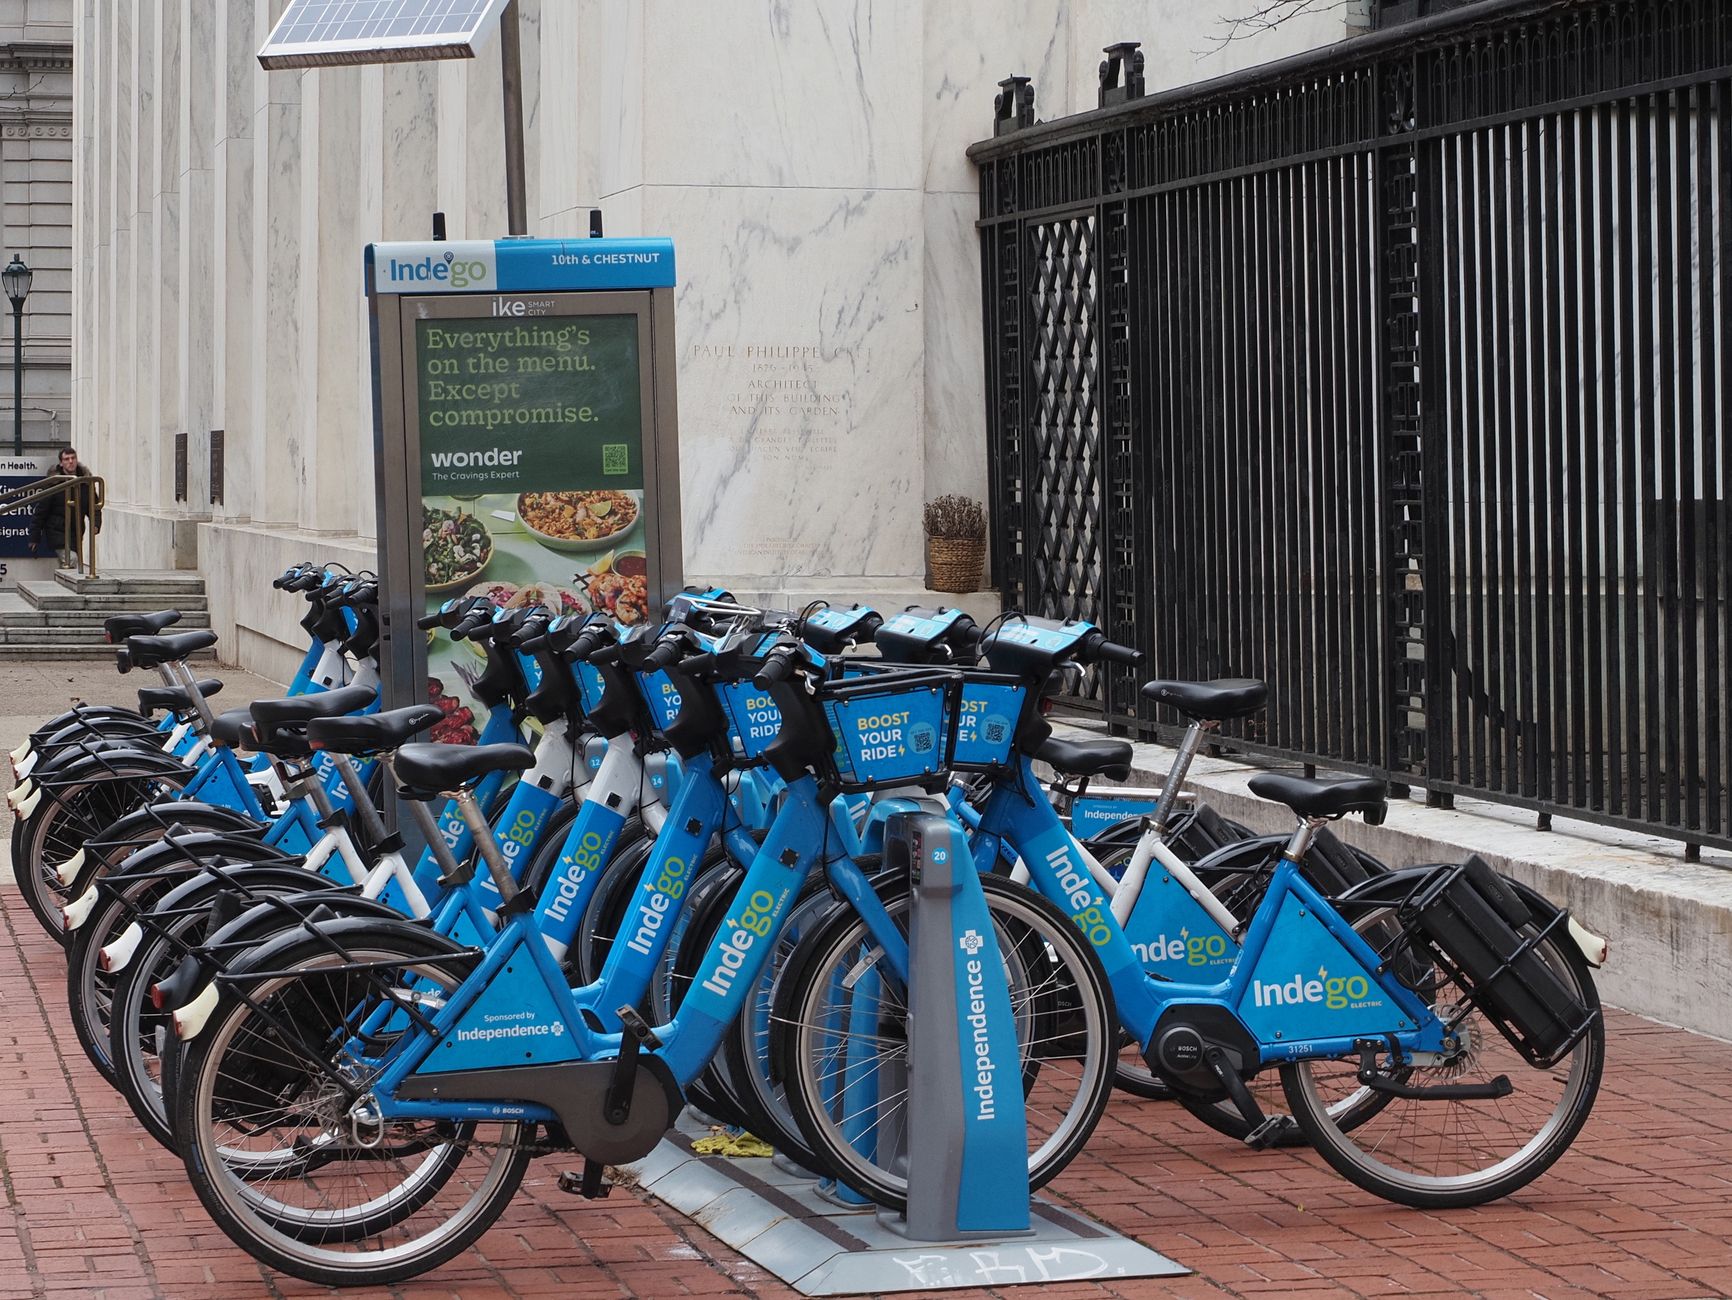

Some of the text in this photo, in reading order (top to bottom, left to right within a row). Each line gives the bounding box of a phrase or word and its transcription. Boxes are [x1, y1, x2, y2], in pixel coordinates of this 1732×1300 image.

[551, 253, 660, 265] 10th & CHESTNUT
[391, 256, 487, 288] Indego
[491, 297, 526, 317] ike
[426, 325, 590, 351] Everything's
[694, 345, 735, 358] PAUL
[747, 346, 821, 358] PHILIPPE
[427, 353, 597, 375] on the menu.
[428, 380, 521, 404] Except
[748, 380, 817, 390] ARCHITECT
[429, 403, 600, 430] compromise.
[729, 405, 757, 416] AND
[8, 461, 38, 471] Health.
[431, 448, 522, 468] wonder
[432, 470, 520, 482] The Cravings Expert
[857, 711, 910, 731] BOOST
[858, 728, 903, 746] YOUR
[860, 744, 897, 762] RIDE
[652, 777, 662, 786] 14
[933, 851, 946, 861] 20
[545, 832, 601, 922] Indego
[627, 856, 685, 956] Indego
[771, 887, 791, 918] ELECTRIC
[1045, 845, 1112, 947] Indego
[702, 890, 774, 998] Indego
[1131, 934, 1227, 966] ndego
[1209, 958, 1236, 966] ELECTRI
[1253, 974, 1369, 1010] Indego
[1350, 1001, 1383, 1009] ELECTRIC
[484, 1011, 535, 1023] Sponsored by
[457, 1024, 549, 1042] Independence
[966, 960, 995, 1120] Independence
[1288, 1044, 1313, 1055] 31251
